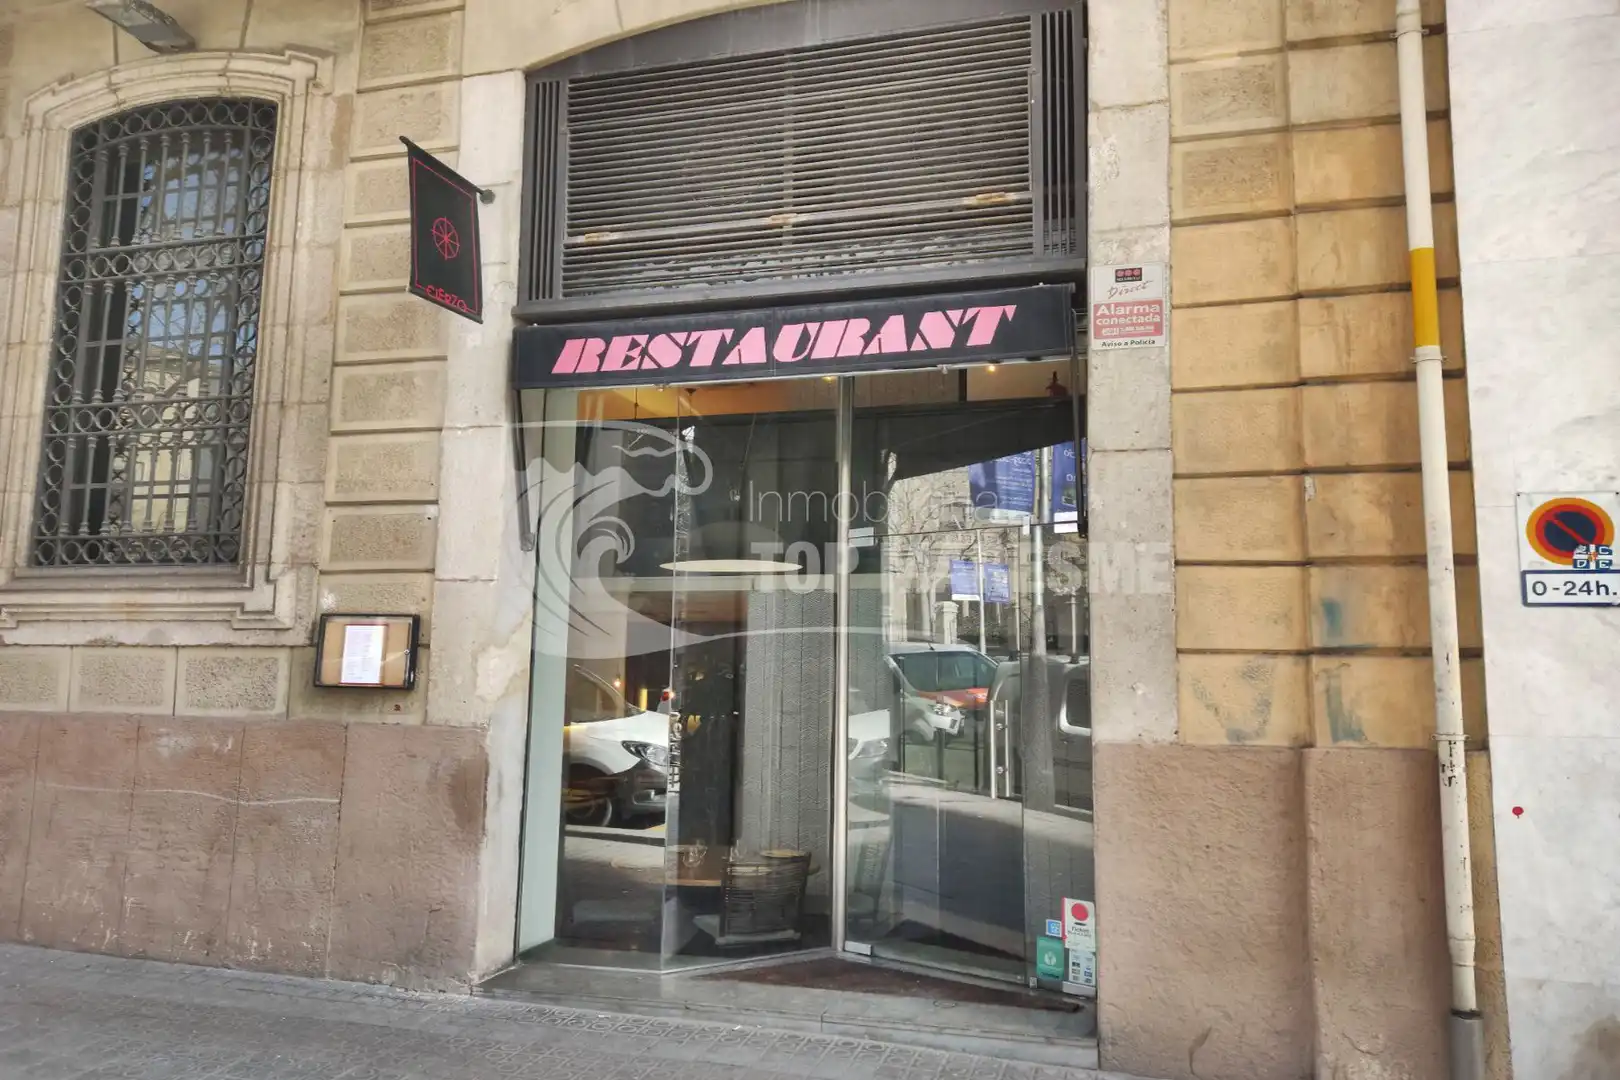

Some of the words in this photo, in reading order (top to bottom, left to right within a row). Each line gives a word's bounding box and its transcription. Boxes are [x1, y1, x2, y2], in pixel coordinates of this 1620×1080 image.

[1096, 304, 1160, 316] Alarma
[1096, 313, 1161, 325] conectada
[551, 305, 1017, 374] RESTAURANT
[1101, 340, 1122, 348] Aviso
